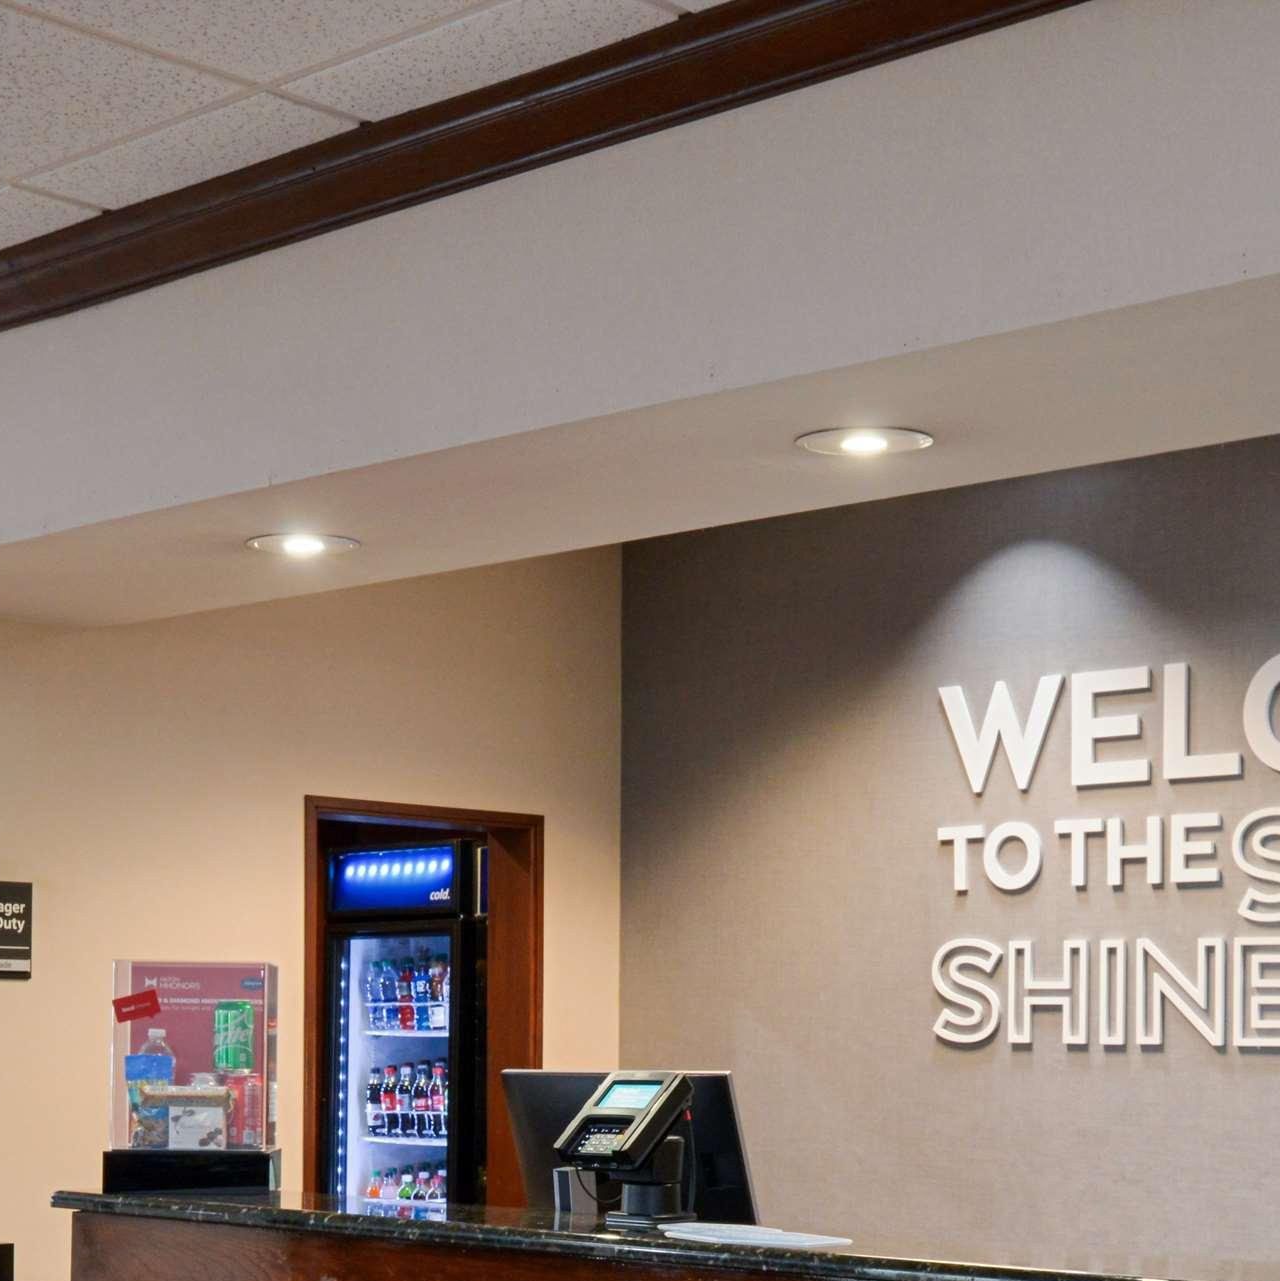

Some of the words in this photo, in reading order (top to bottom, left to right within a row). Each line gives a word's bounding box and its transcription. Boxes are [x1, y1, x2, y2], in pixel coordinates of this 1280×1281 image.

[937, 821, 1042, 892] TO
[1053, 811, 1223, 886] THE
[429, 887, 451, 901] cold.
